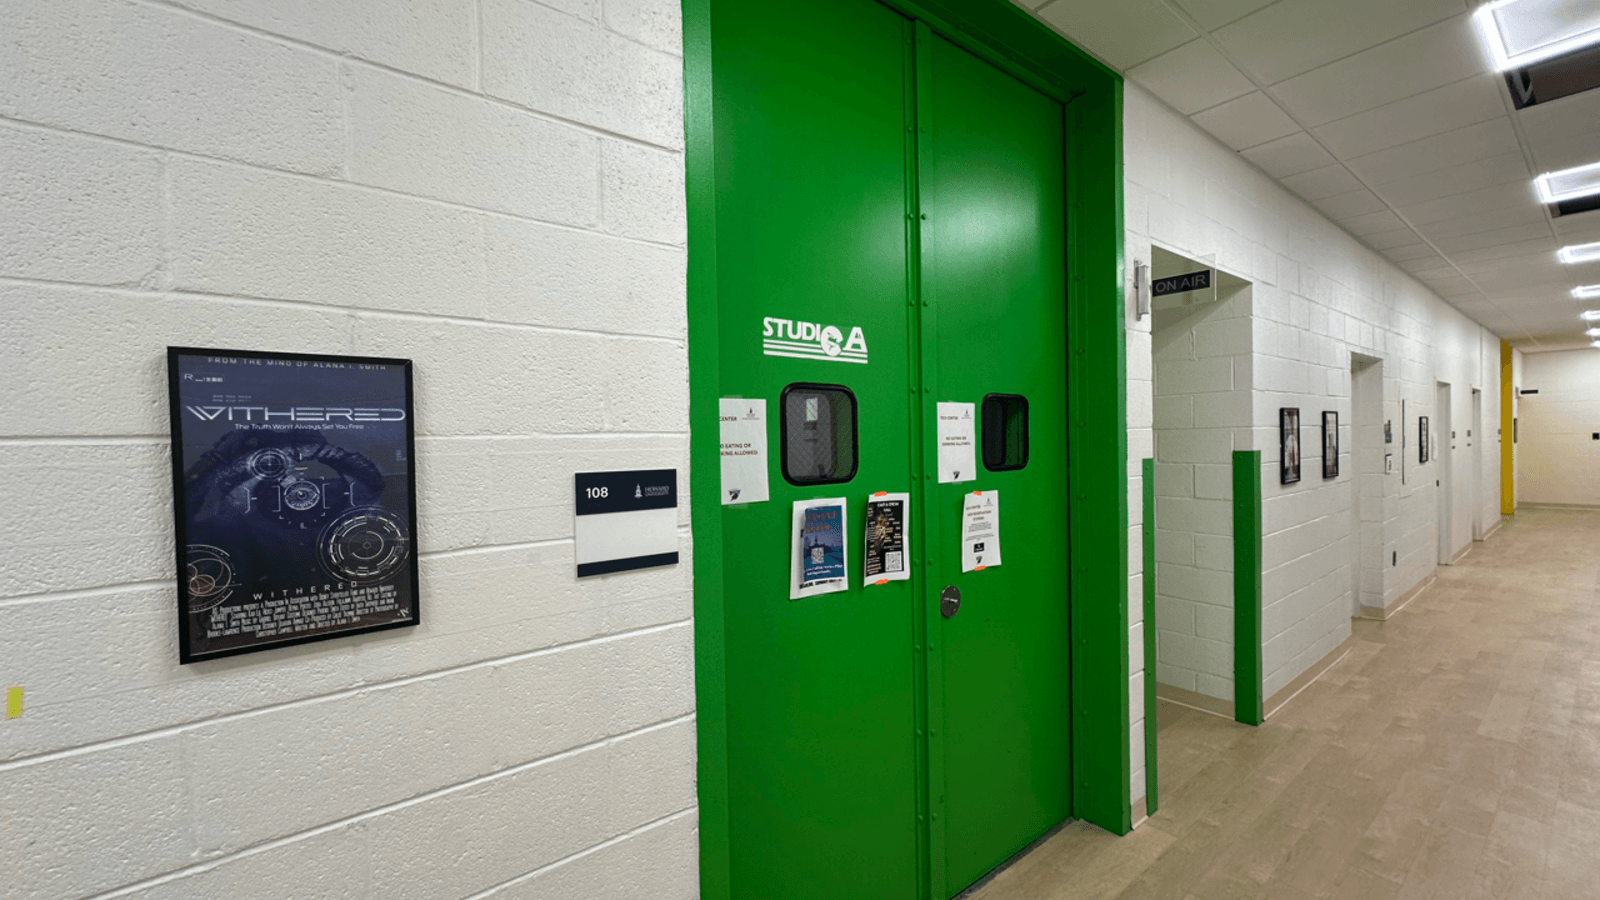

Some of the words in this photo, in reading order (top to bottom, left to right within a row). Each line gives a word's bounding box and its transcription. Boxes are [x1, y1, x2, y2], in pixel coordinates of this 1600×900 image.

[1156, 280, 1176, 292] ON
[1180, 274, 1206, 289] AIR
[842, 326, 868, 352] A
[243, 358, 262, 366] THE
[267, 359, 292, 367] MIND
[185, 405, 407, 421] WITHERED
[294, 423, 321, 431] Always
[585, 486, 609, 499] 108
[253, 580, 357, 600] WITHERED
